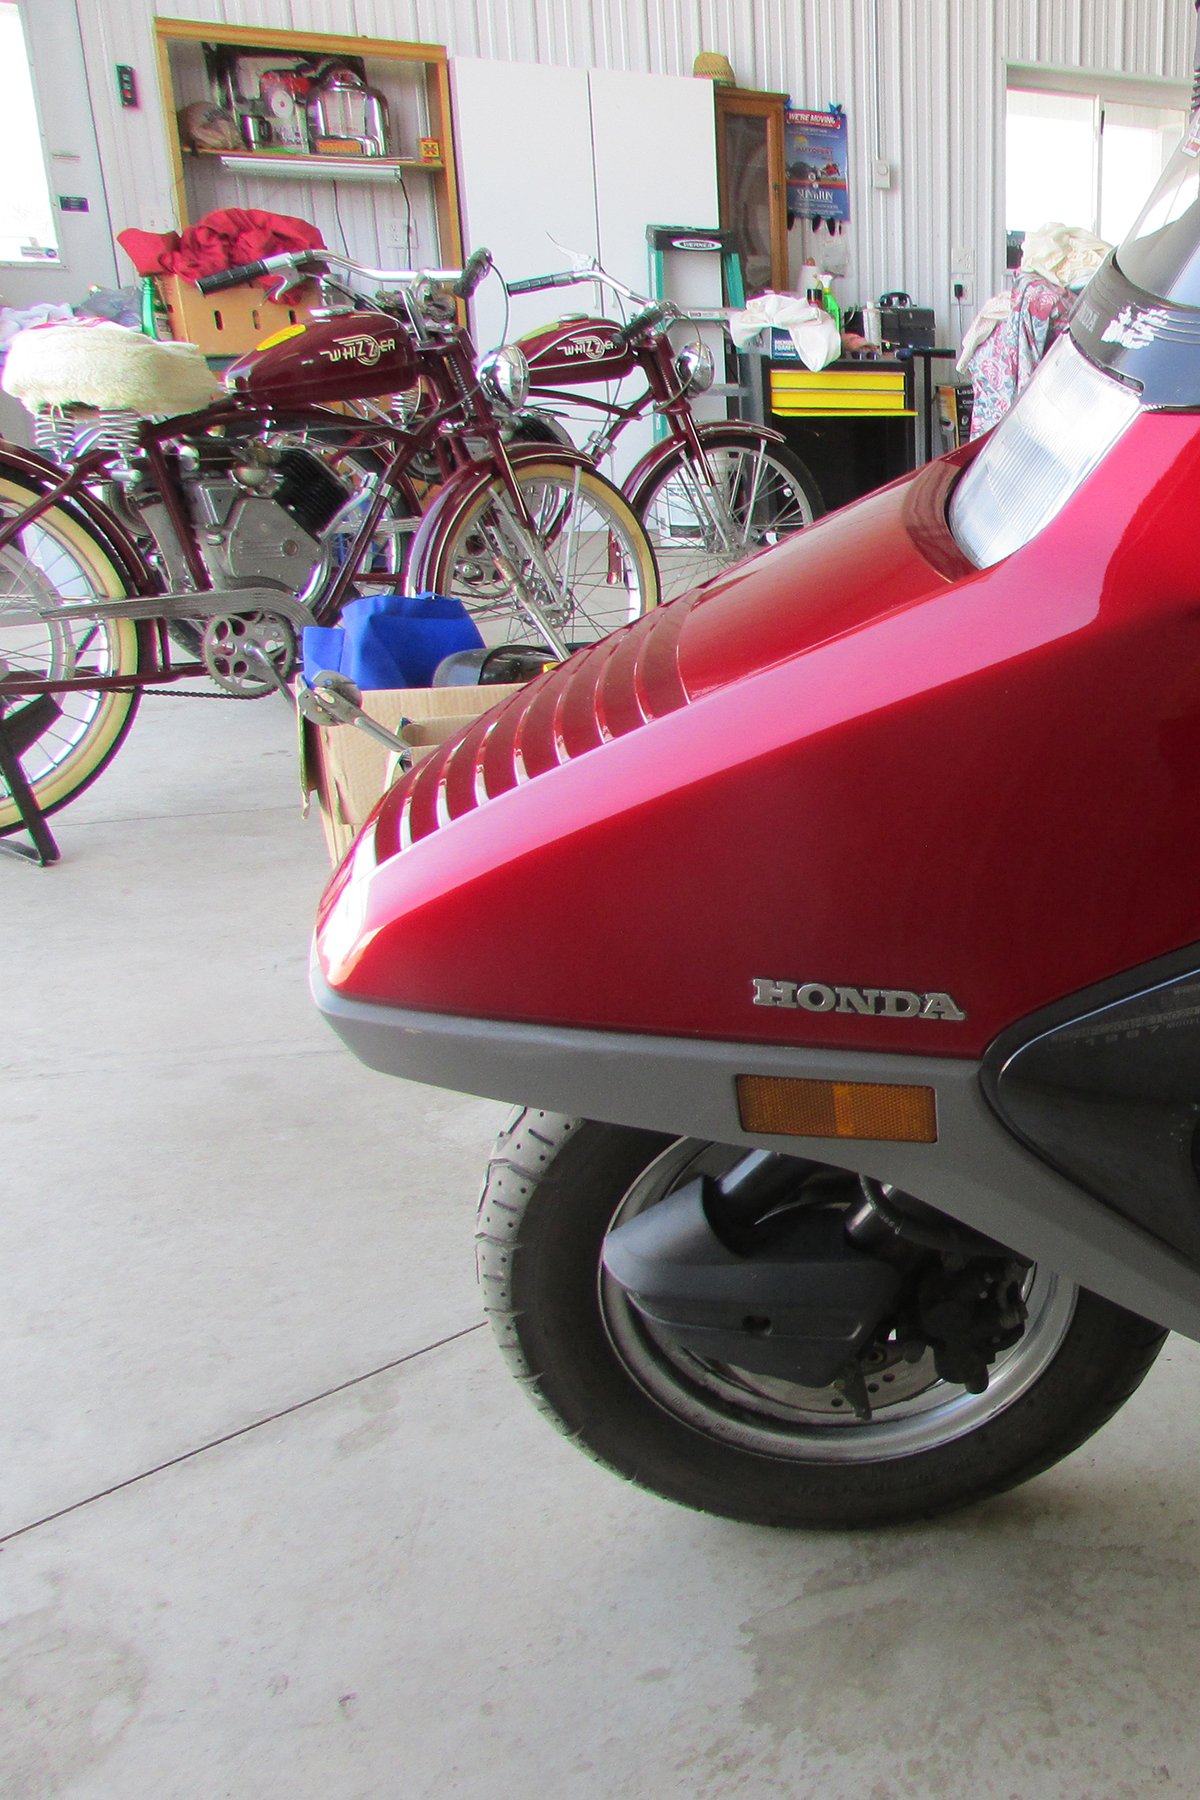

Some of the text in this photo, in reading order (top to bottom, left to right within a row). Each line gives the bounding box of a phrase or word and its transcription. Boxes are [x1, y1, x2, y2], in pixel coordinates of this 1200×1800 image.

[789, 113, 810, 121] WE'RE
[319, 336, 396, 364] WHIZZER
[752, 977, 967, 1022] HONDA
